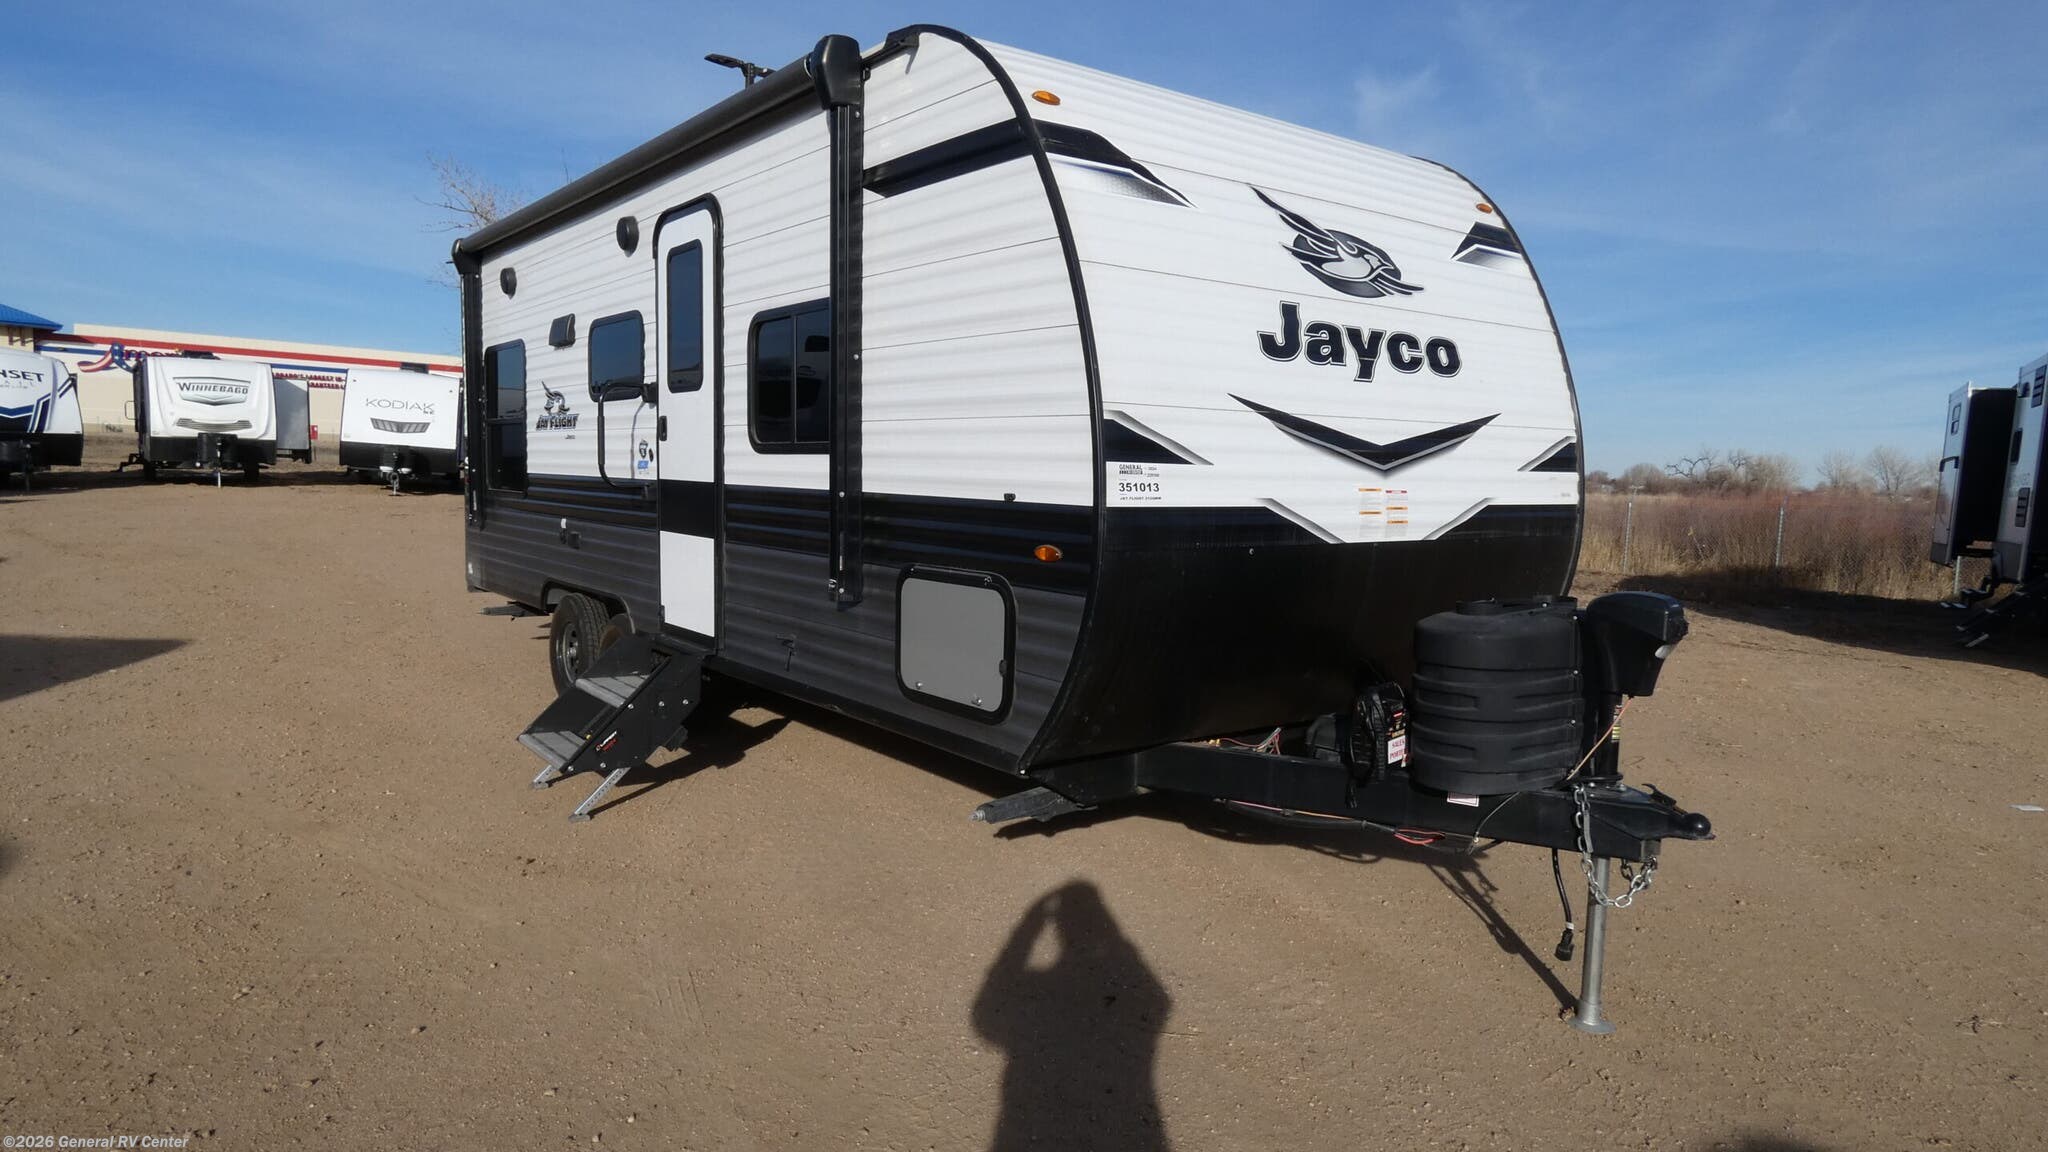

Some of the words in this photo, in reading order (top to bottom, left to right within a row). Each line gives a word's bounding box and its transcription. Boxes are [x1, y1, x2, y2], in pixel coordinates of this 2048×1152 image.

[1257, 300, 1462, 383] Jayco
[177, 382, 249, 395] WINNEBAGO
[366, 398, 434, 412] KODIAK
[550, 413, 579, 430] FLIGHT
[1118, 482, 1160, 492] 351013
